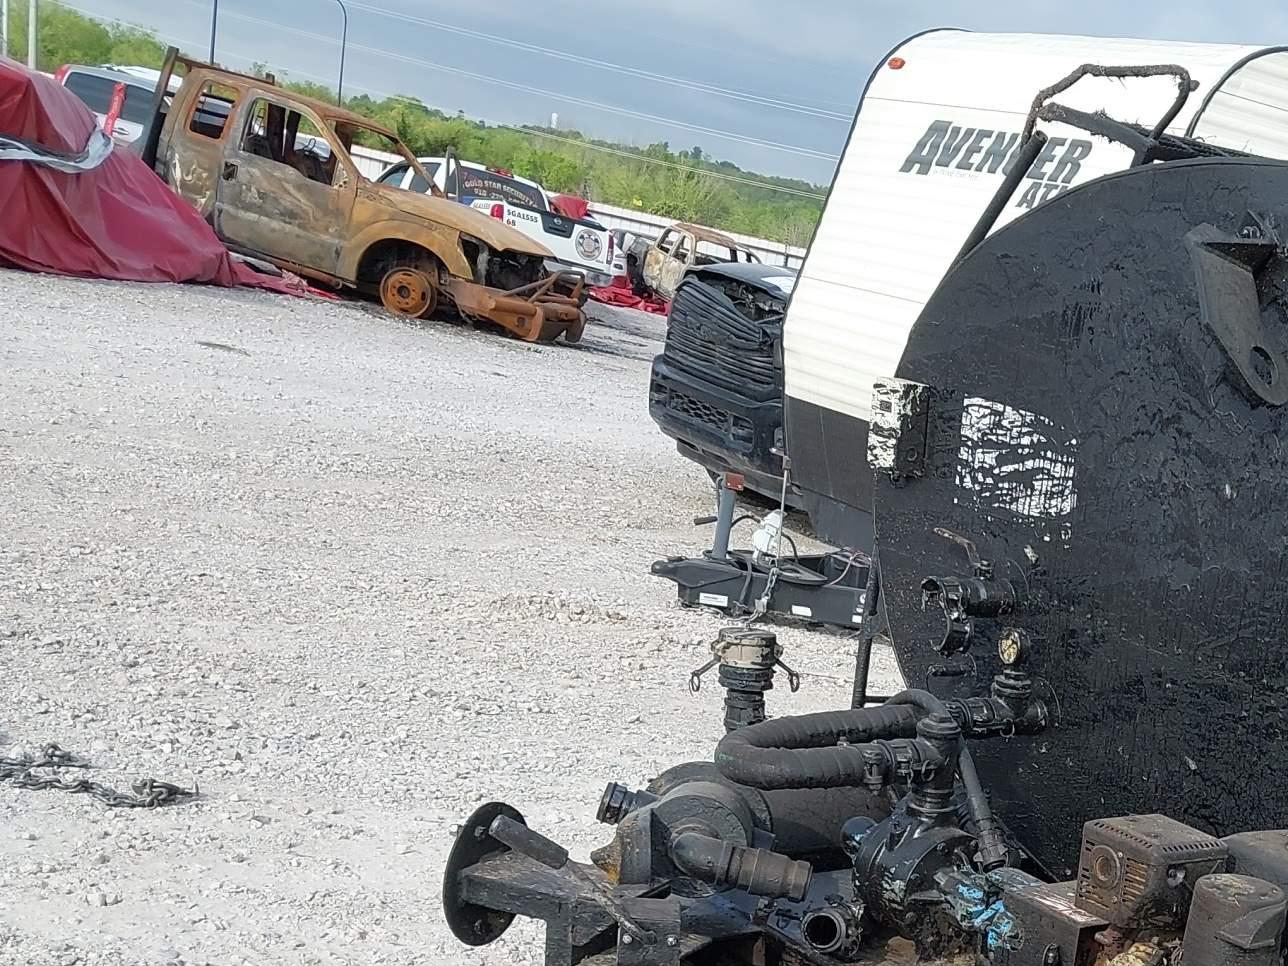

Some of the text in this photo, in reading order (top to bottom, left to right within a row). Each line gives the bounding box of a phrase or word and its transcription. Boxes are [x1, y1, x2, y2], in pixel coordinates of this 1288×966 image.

[464, 180, 483, 188] GOLD
[484, 180, 501, 190] STAR
[502, 185, 534, 205] SECURITY
[1015, 181, 1070, 209] AT
